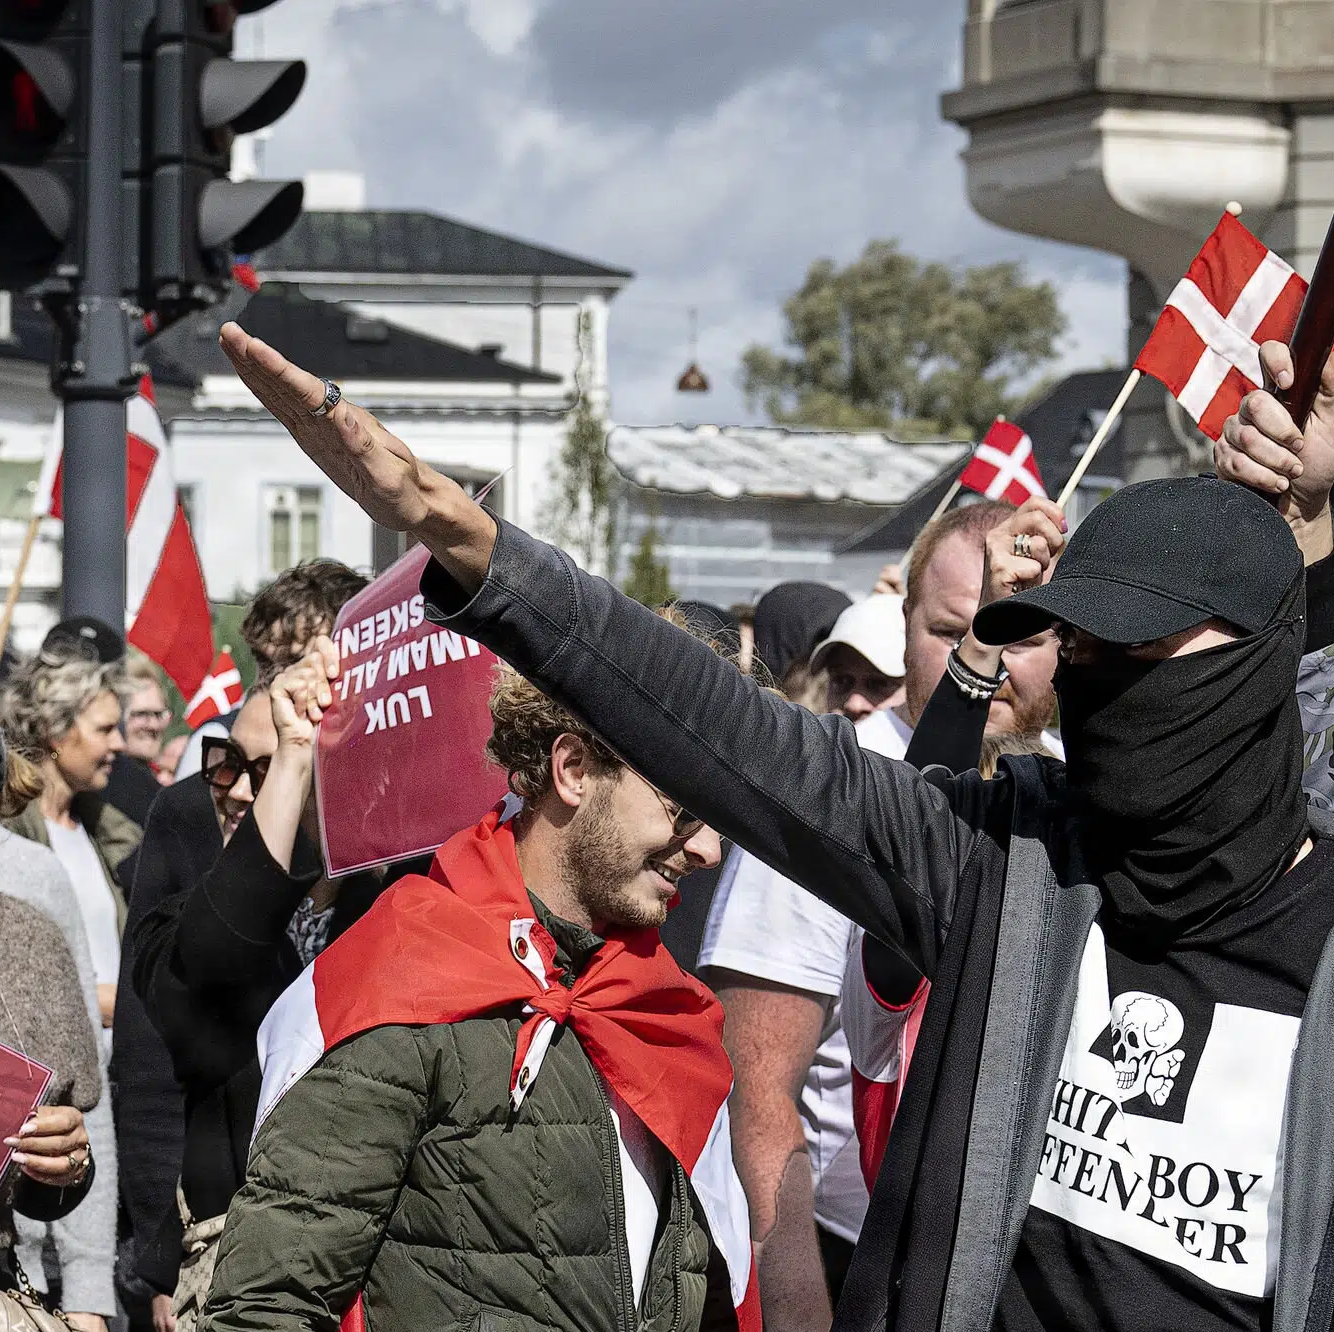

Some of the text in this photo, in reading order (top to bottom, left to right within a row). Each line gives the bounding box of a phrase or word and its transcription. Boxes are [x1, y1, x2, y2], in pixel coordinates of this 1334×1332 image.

[334, 629, 481, 701] IMAM ALI-
[364, 684, 434, 735] LUK
[1147, 1153, 1263, 1212] BOY
